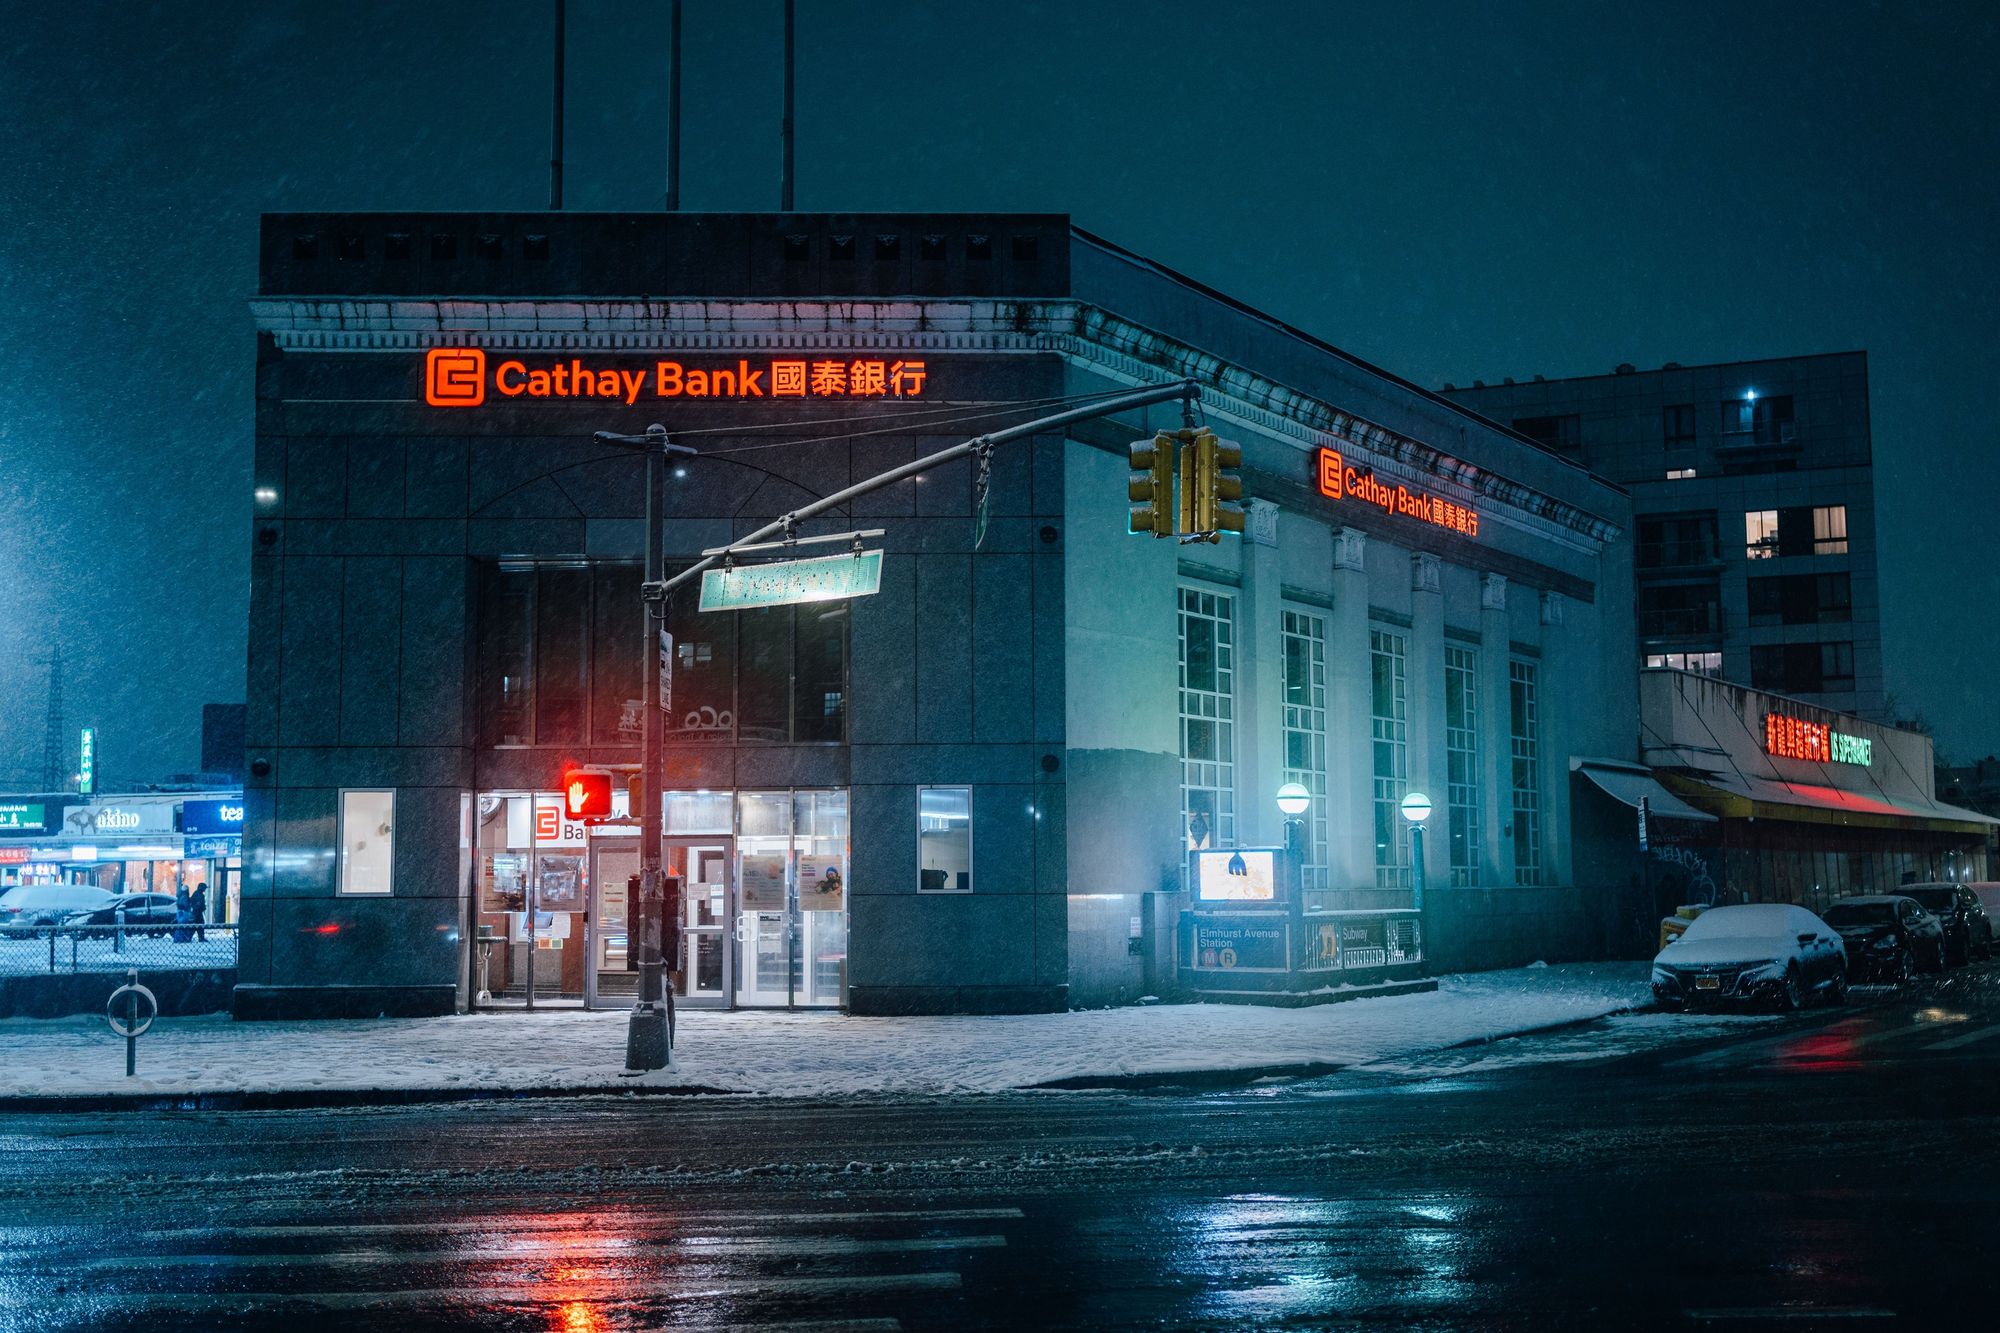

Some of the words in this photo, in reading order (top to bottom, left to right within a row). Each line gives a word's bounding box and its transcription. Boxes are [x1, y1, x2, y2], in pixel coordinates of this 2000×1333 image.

[496, 360, 645, 404] Cathay
[657, 360, 763, 397] Bank
[771, 360, 925, 396] 國泰銀行
[1345, 467, 1396, 515] Cathay
[1398, 485, 1432, 523] Bank
[1433, 497, 1478, 537] 國泰銀行
[1830, 731, 1839, 762] US
[1200, 928, 1241, 938] Elmhurst
[1244, 928, 1280, 938] Avenue
[1343, 927, 1368, 942] Subway
[1200, 938, 1233, 947] Station
[1205, 952, 1216, 963] M
[1224, 952, 1233, 963] R
